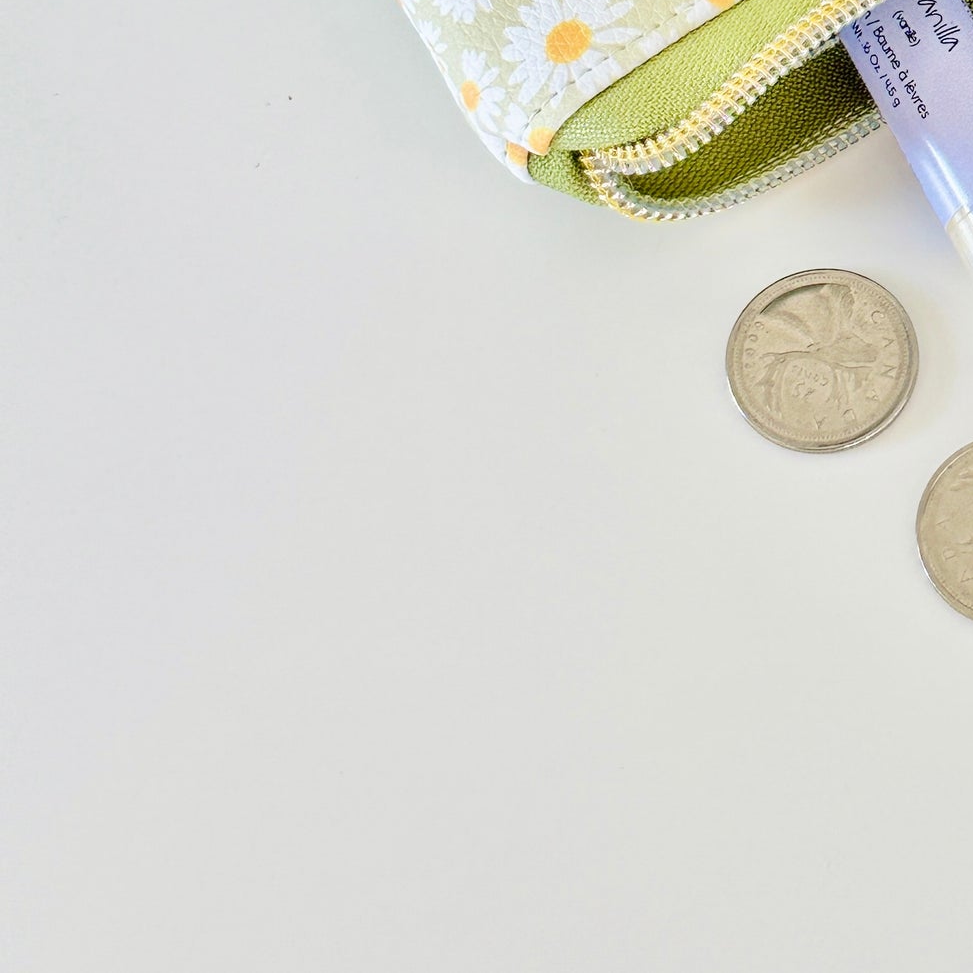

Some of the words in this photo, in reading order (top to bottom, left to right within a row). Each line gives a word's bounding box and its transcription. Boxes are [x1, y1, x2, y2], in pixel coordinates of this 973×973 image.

[872, 25, 901, 70] Baume
[869, 53, 881, 74] Oz
[892, 97, 901, 108] g
[898, 69, 909, 82] à
[903, 79, 930, 120] lèvres
